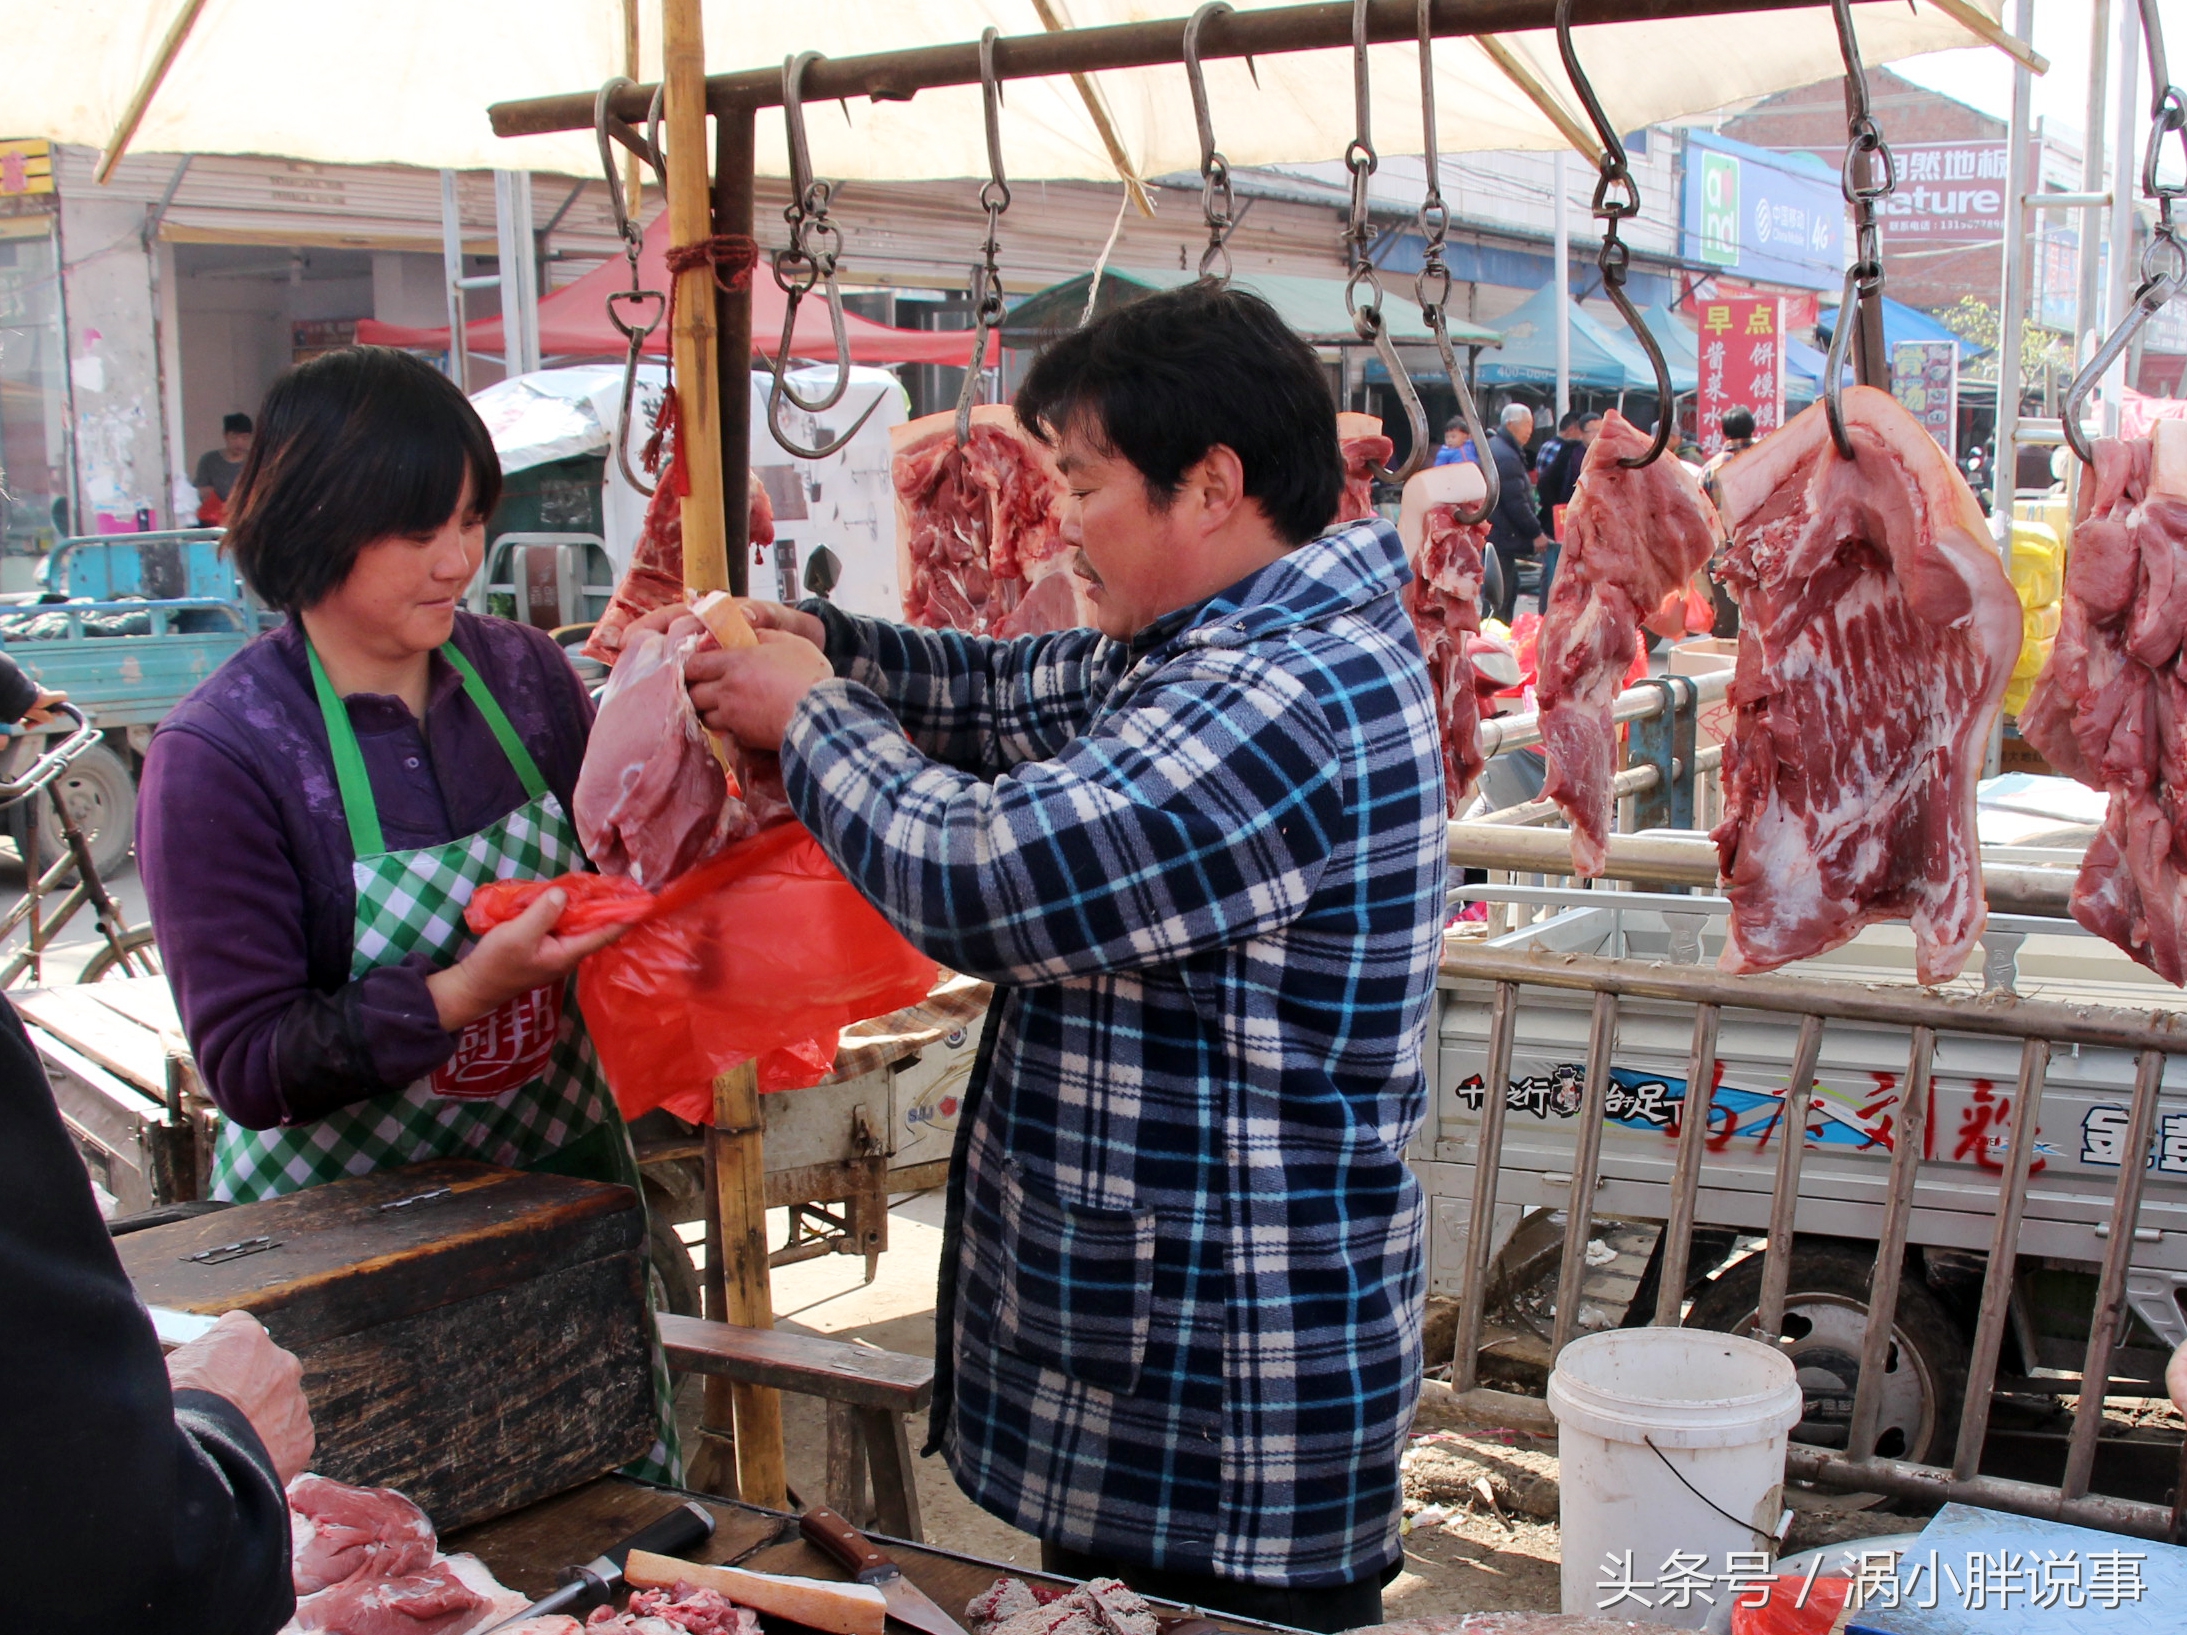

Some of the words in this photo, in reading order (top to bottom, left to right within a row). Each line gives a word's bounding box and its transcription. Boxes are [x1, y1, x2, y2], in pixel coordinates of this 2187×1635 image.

[1772, 205, 1805, 230] 中国移动
[1812, 216, 1829, 251] 4G
[1704, 304, 1773, 336] 早点
